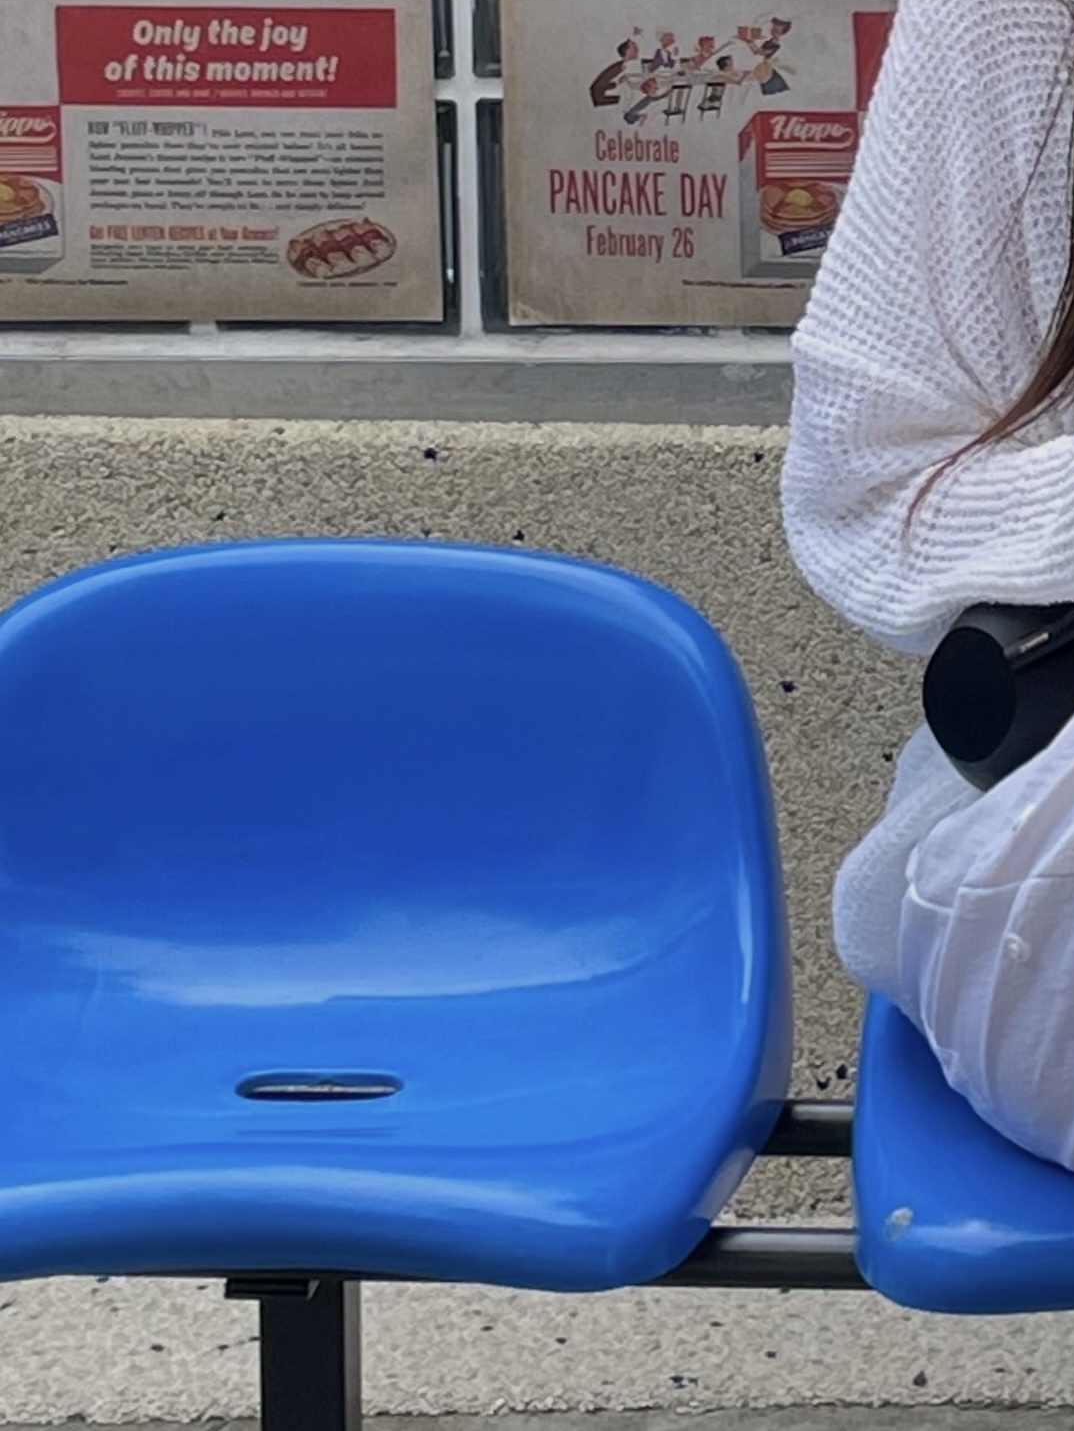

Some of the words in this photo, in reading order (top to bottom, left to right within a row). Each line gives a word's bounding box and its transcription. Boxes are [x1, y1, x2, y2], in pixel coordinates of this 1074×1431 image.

[132, 19, 201, 52] Only
[207, 19, 256, 46] the
[259, 17, 308, 52] joy
[104, 54, 139, 81] of
[143, 53, 201, 82] this
[205, 56, 339, 82] moment!
[0, 112, 54, 136] ippo
[770, 115, 845, 142] Hippo
[594, 129, 680, 164] Celebrate
[549, 169, 668, 217] PANCAKE
[680, 172, 727, 219] DAY
[586, 224, 665, 264] February
[671, 226, 695, 259] 26
